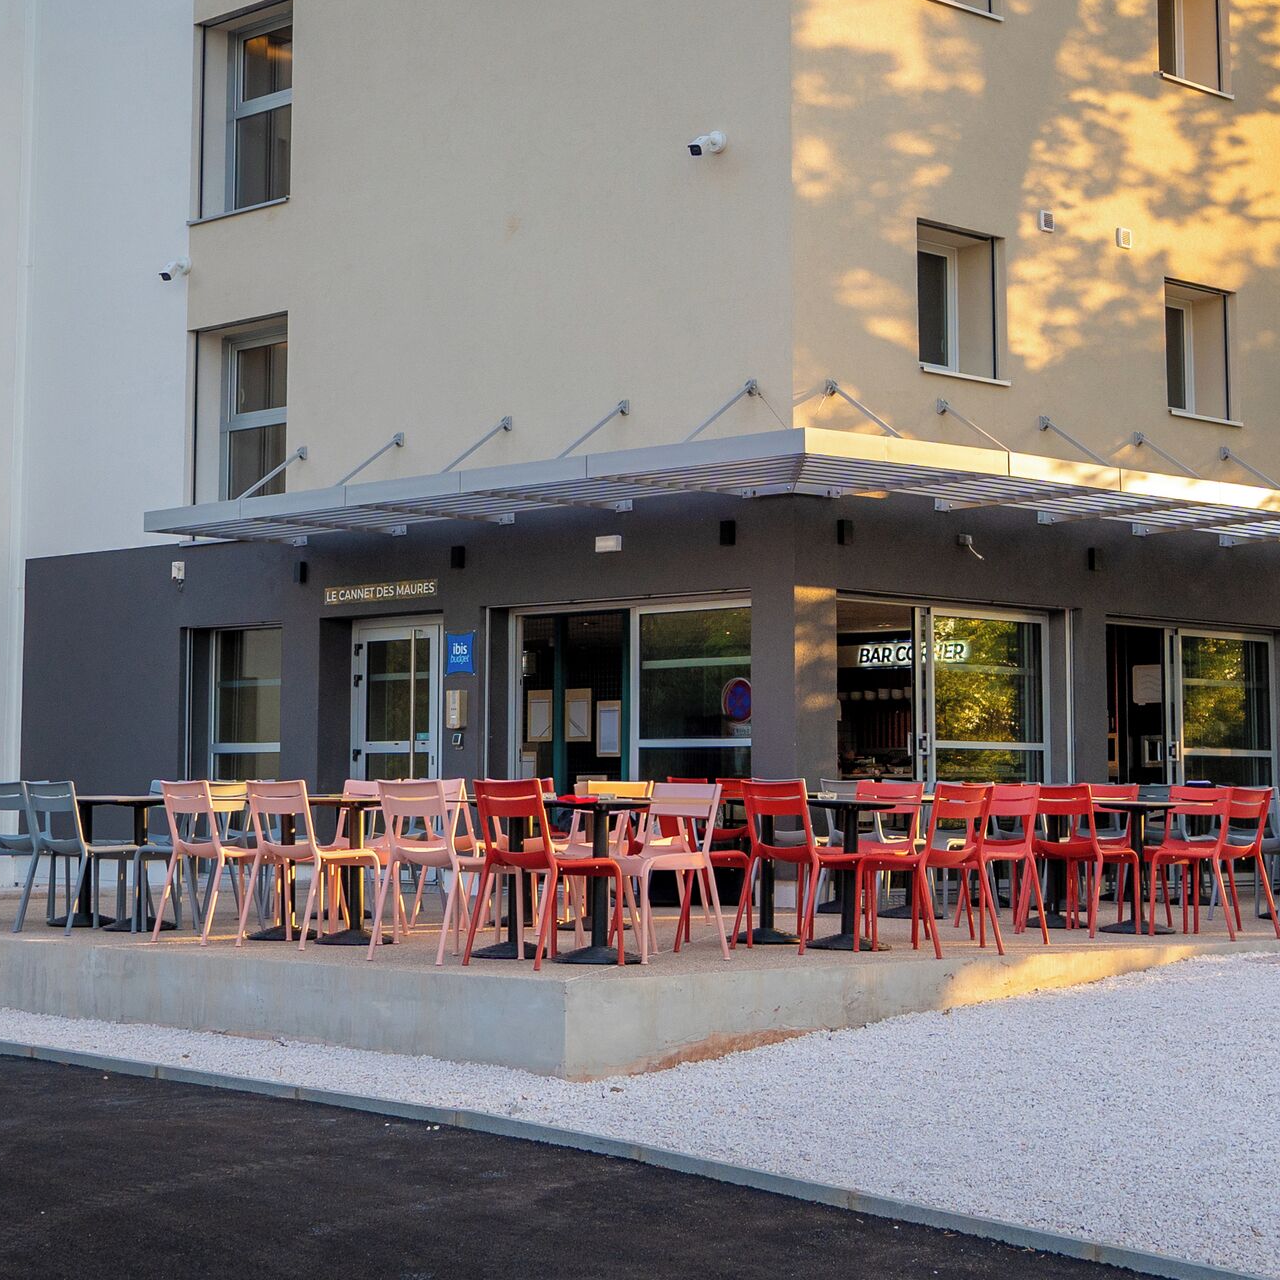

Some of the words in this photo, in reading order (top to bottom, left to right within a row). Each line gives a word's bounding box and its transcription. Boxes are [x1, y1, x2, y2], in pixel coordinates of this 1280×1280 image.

[326, 591, 337, 602] LE
[338, 587, 375, 601] CANNET
[376, 585, 395, 598] DES
[396, 582, 435, 596] MAURES
[452, 642, 468, 655] ibis
[859, 647, 892, 663] BAR
[450, 654, 470, 665] budget
